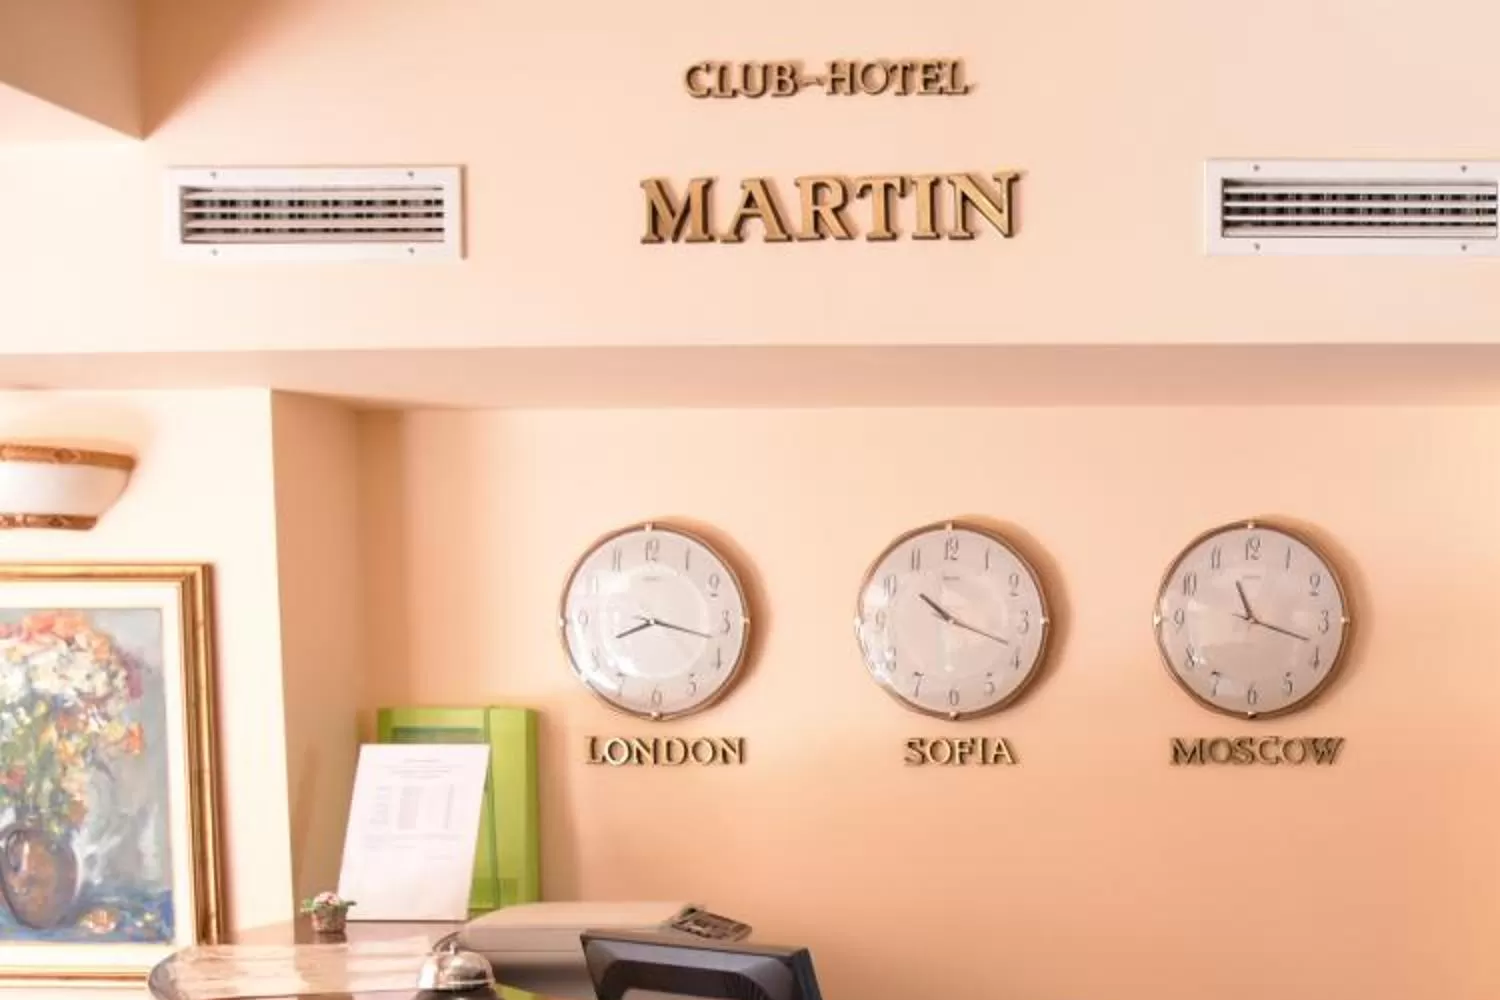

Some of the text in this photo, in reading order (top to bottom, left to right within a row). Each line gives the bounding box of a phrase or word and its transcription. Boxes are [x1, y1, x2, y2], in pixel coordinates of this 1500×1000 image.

[639, 171, 1023, 243] MARTIN
[612, 545, 622, 572] 11
[645, 538, 660, 561] 12
[684, 546, 691, 571] 1
[911, 547, 921, 571] 11
[943, 538, 959, 561] 12
[984, 545, 991, 571] 1
[1211, 544, 1221, 570] 11
[1245, 536, 1261, 561] 12
[1285, 546, 1291, 571] 1
[708, 573, 720, 597] 2
[883, 573, 897, 597] 10
[1008, 572, 1020, 597] 2
[1183, 572, 1197, 597] 10
[1309, 572, 1321, 597] 2
[721, 610, 731, 635] 3
[1018, 610, 1029, 634] 3
[1174, 607, 1185, 633] 9
[1318, 609, 1329, 634] 3
[711, 646, 722, 670] 4
[1010, 646, 1021, 670] 4
[1185, 646, 1195, 669] 8
[1310, 646, 1320, 669] 4
[616, 671, 626, 698] 7
[651, 683, 662, 708] 6
[687, 674, 697, 698] 5
[913, 671, 924, 698] 7
[948, 684, 960, 707] 6
[983, 672, 995, 697] 5
[1211, 670, 1221, 697] 7
[1247, 682, 1257, 706] 6
[1283, 671, 1293, 697] 5
[584, 735, 745, 766] LONDON
[903, 737, 1018, 766] SOFIA
[1170, 736, 1345, 766] MOSCOW
